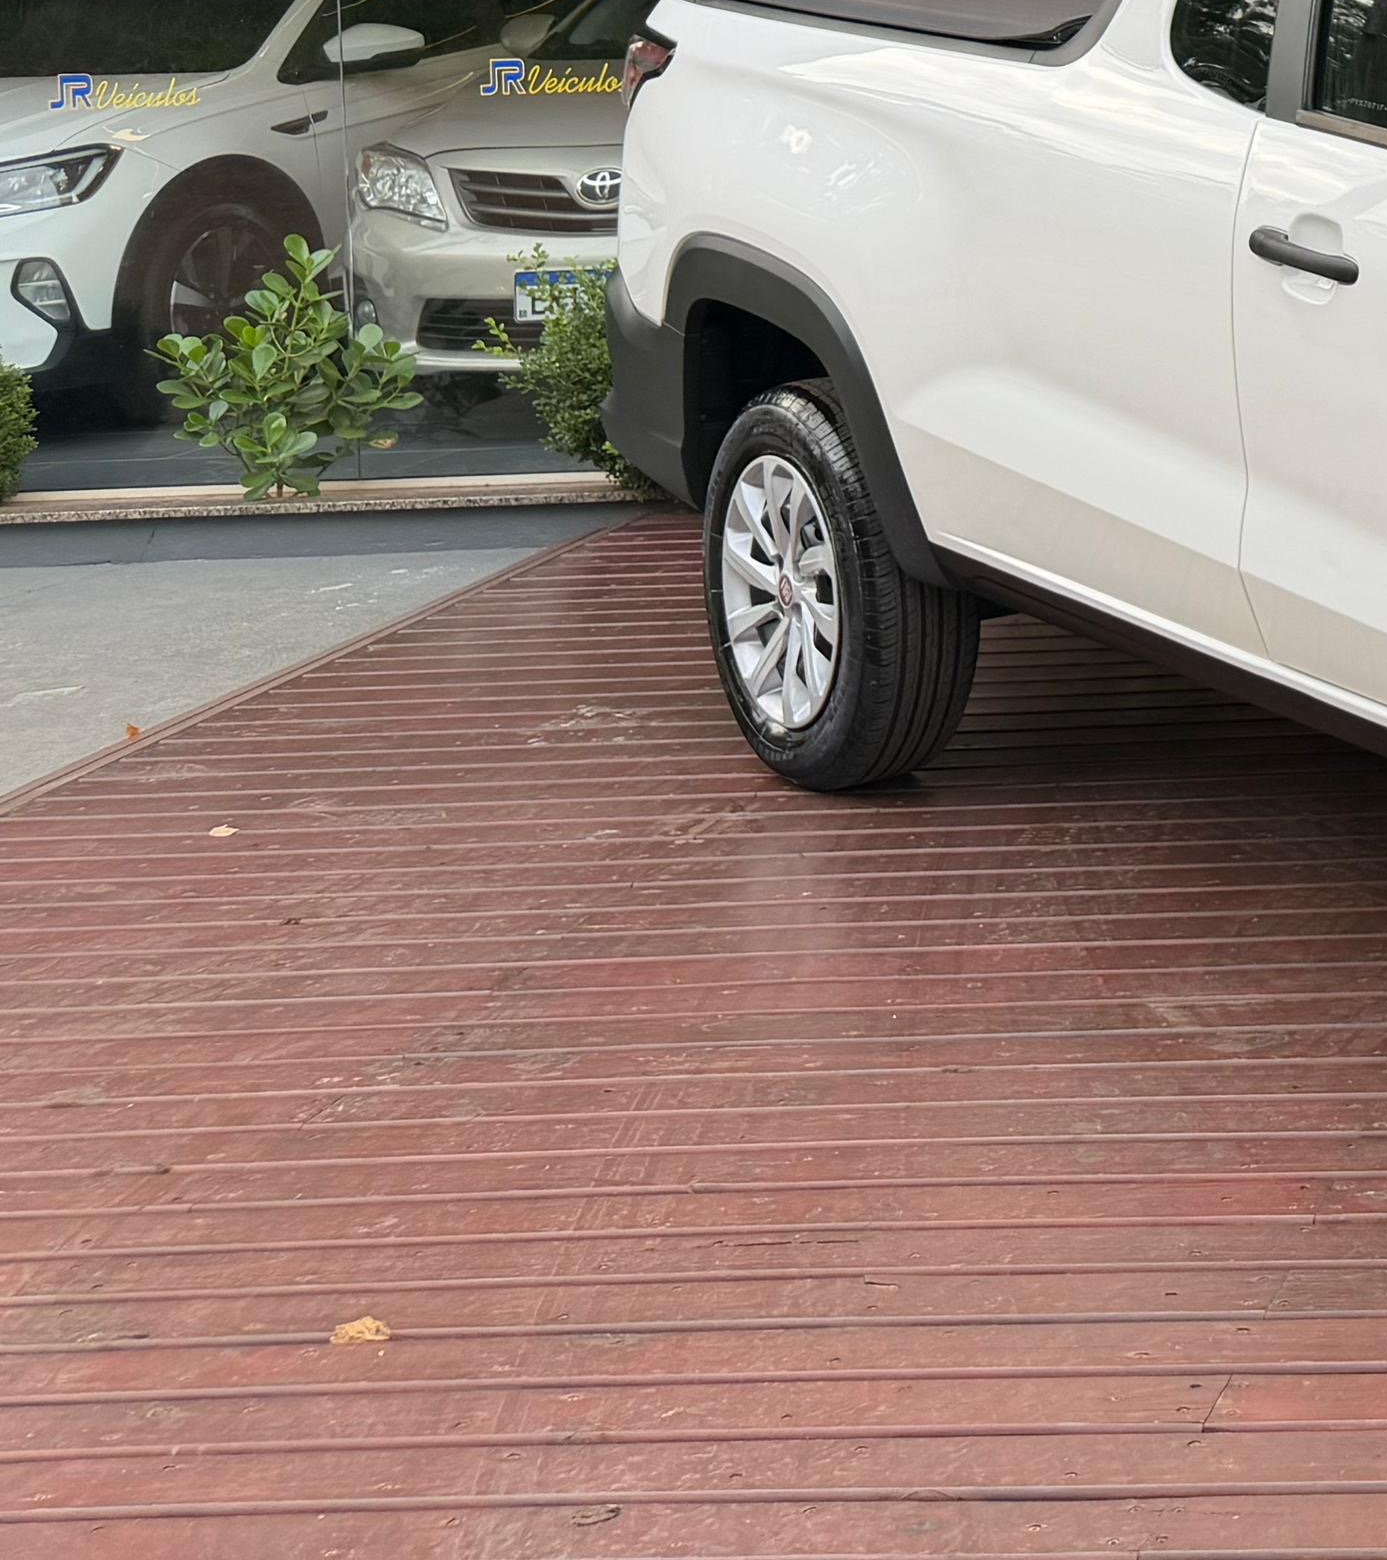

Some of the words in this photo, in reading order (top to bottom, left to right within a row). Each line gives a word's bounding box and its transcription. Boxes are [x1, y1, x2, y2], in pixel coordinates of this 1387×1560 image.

[48, 73, 94, 111] JR
[480, 58, 526, 96] JR
[528, 62, 622, 95] Veículo
